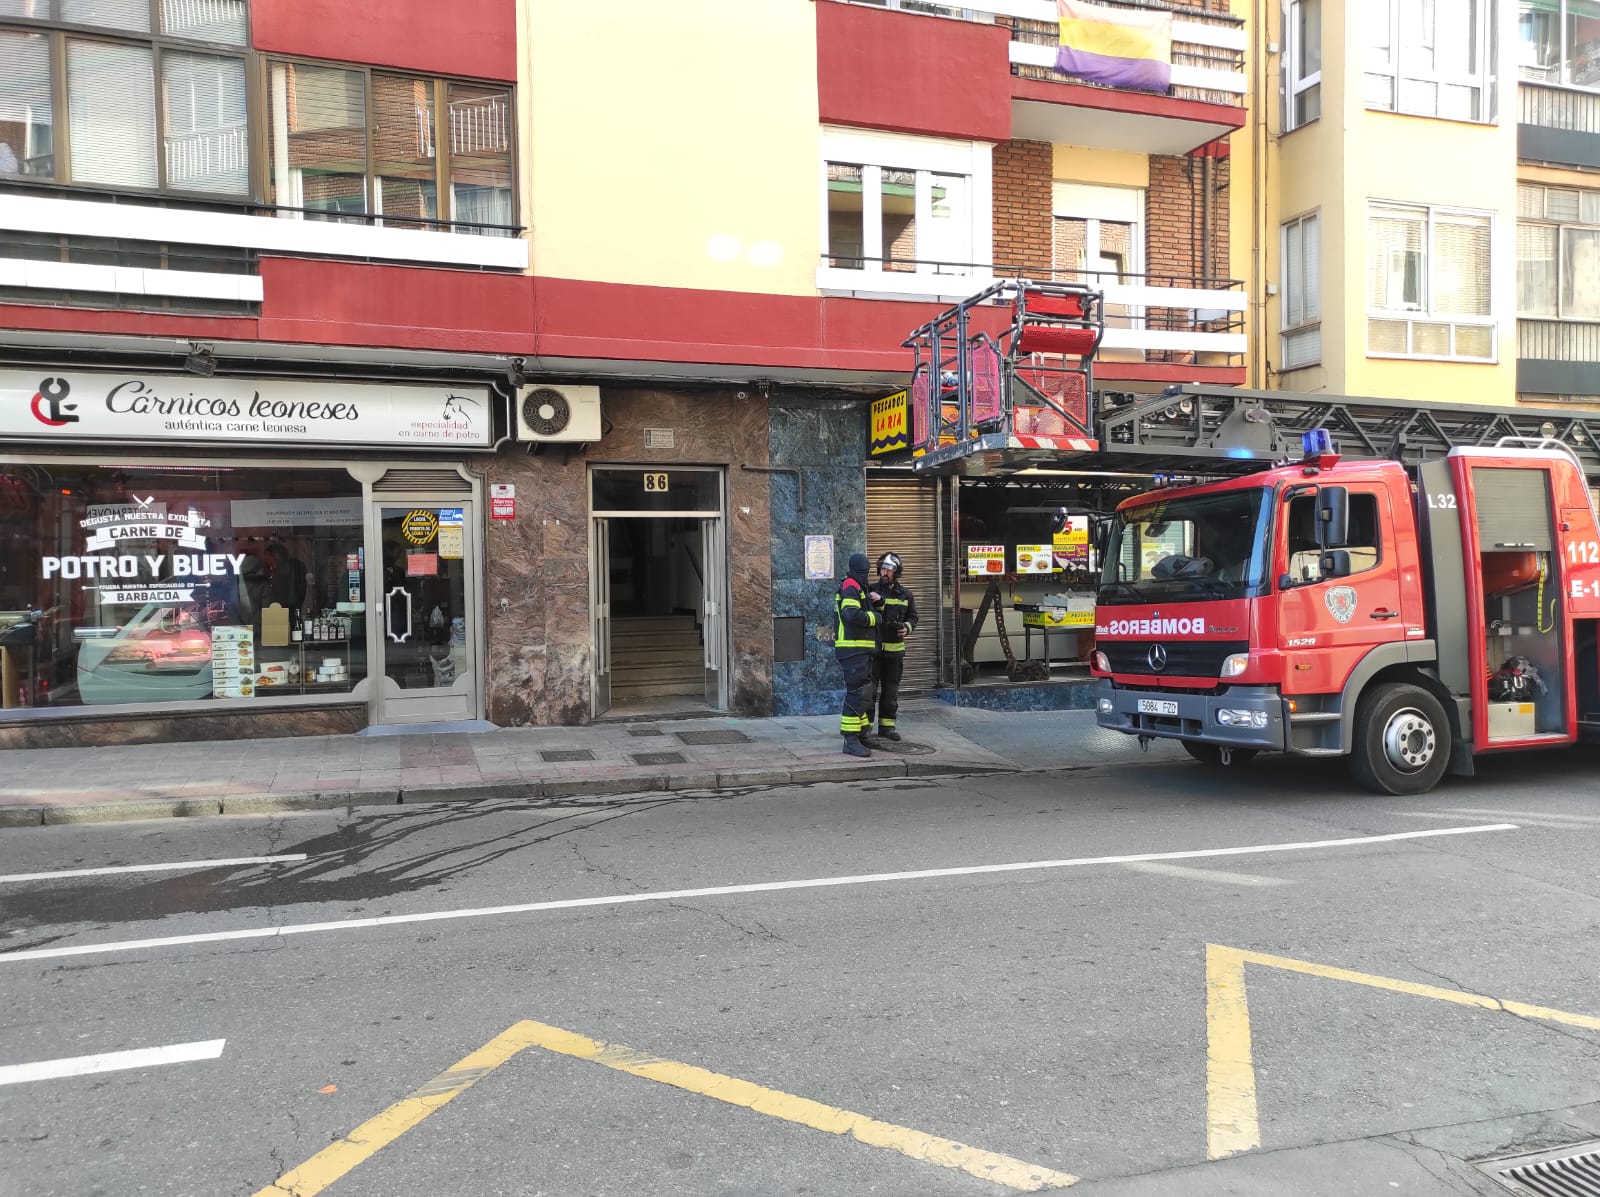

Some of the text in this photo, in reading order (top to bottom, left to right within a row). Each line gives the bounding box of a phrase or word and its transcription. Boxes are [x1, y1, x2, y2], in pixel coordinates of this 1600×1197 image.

[105, 380, 359, 420] Cárnicos leoneses
[873, 394, 905, 415] PESCADOS
[165, 420, 307, 433] auténtica carne leonesa
[411, 421, 468, 430] especialidad
[876, 418, 885, 432] LA
[413, 430, 440, 438] carne
[442, 430, 454, 438] de
[456, 430, 480, 440] potro
[646, 475, 666, 490] 86
[1427, 493, 1457, 508] L32
[80, 513, 121, 528] DEGUSTA
[124, 512, 165, 521] NUESTRA
[109, 526, 184, 538] CARNE DE
[1567, 541, 1600, 563] 112
[42, 553, 246, 579] POTRO Y BUEY
[117, 591, 180, 601] BARBACOA
[1571, 580, 1600, 597] E-1
